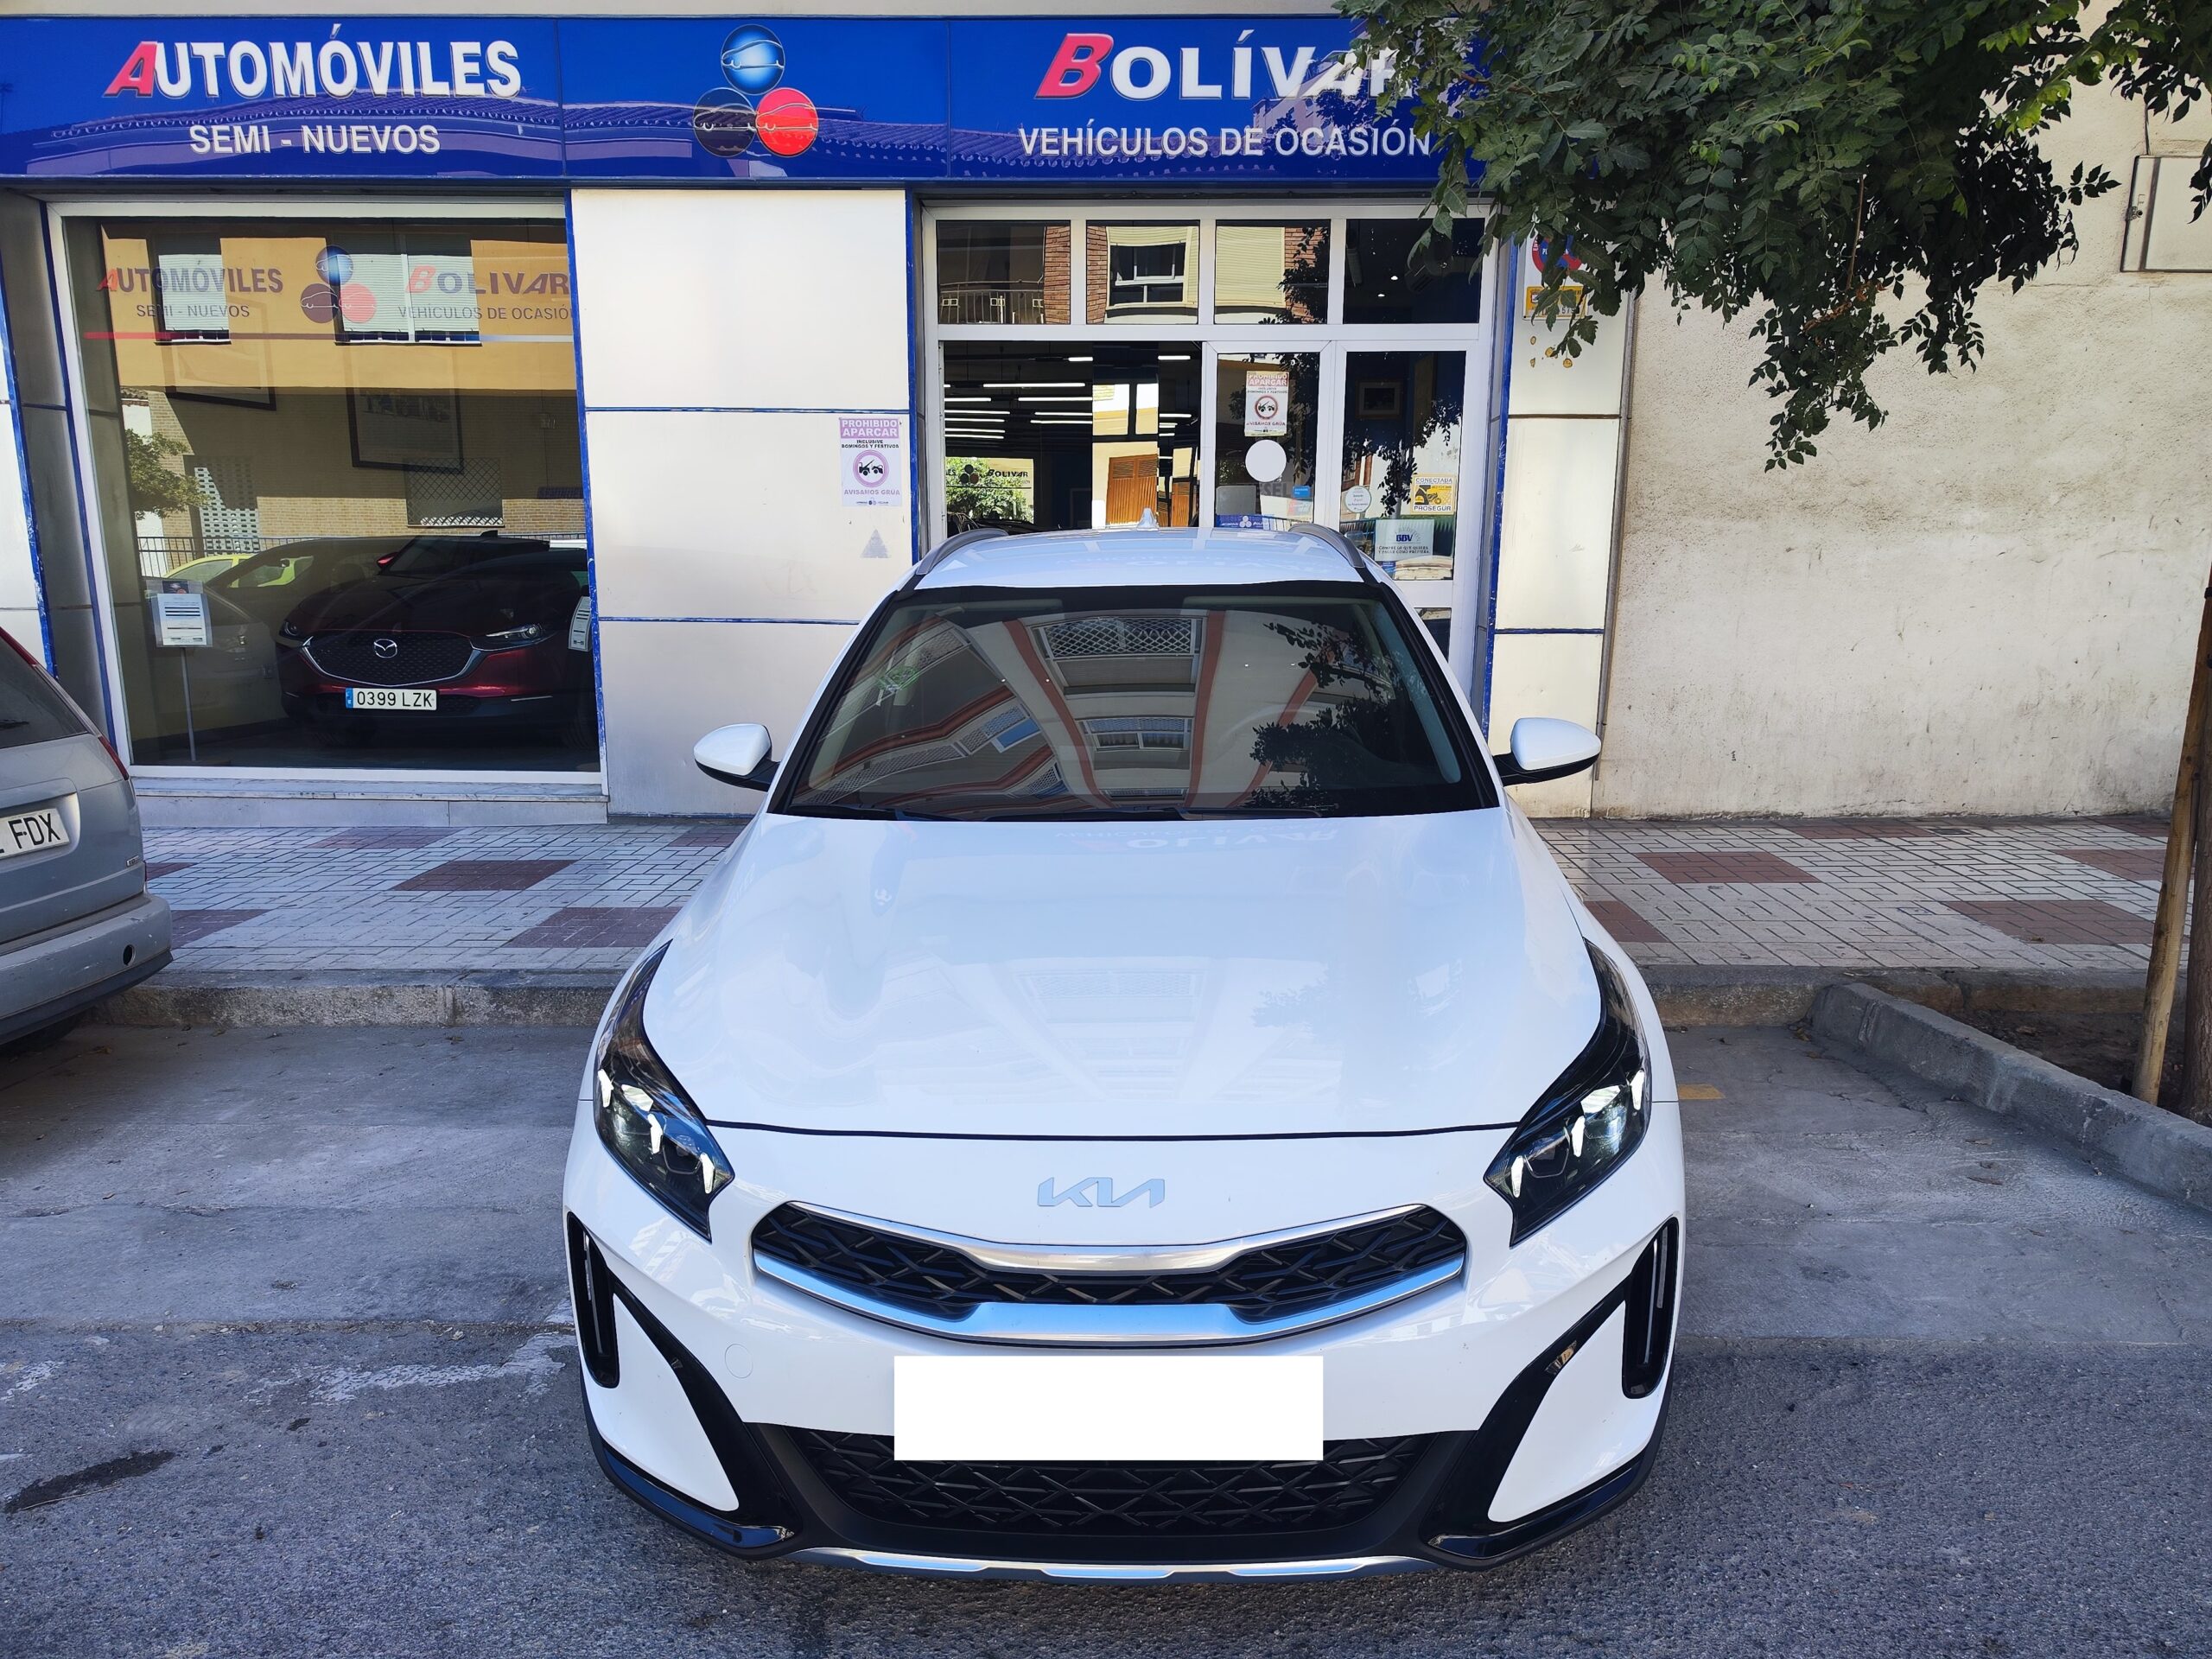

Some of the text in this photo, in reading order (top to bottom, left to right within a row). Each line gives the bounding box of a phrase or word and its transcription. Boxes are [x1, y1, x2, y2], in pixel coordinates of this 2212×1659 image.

[105, 24, 521, 99] AUTOMÓVILES
[189, 124, 270, 154] SEMI
[302, 124, 441, 155] NUEVOS
[1018, 118, 1433, 157] VEHÍCULOS DE OCASIÓN
[97, 260, 283, 293] AUTOMÓVILES
[137, 304, 174, 318] SEMI
[188, 304, 250, 318] NUEVOS
[487, 307, 507, 320] DE
[512, 304, 573, 320] OCASIÓ
[842, 419, 898, 428] PROHIBIDO
[842, 428, 898, 437] APARCAR
[357, 691, 396, 706] 0399
[402, 692, 432, 707] LZK
[8, 813, 60, 849] FDX
[1038, 1177, 1166, 1208] KIA
